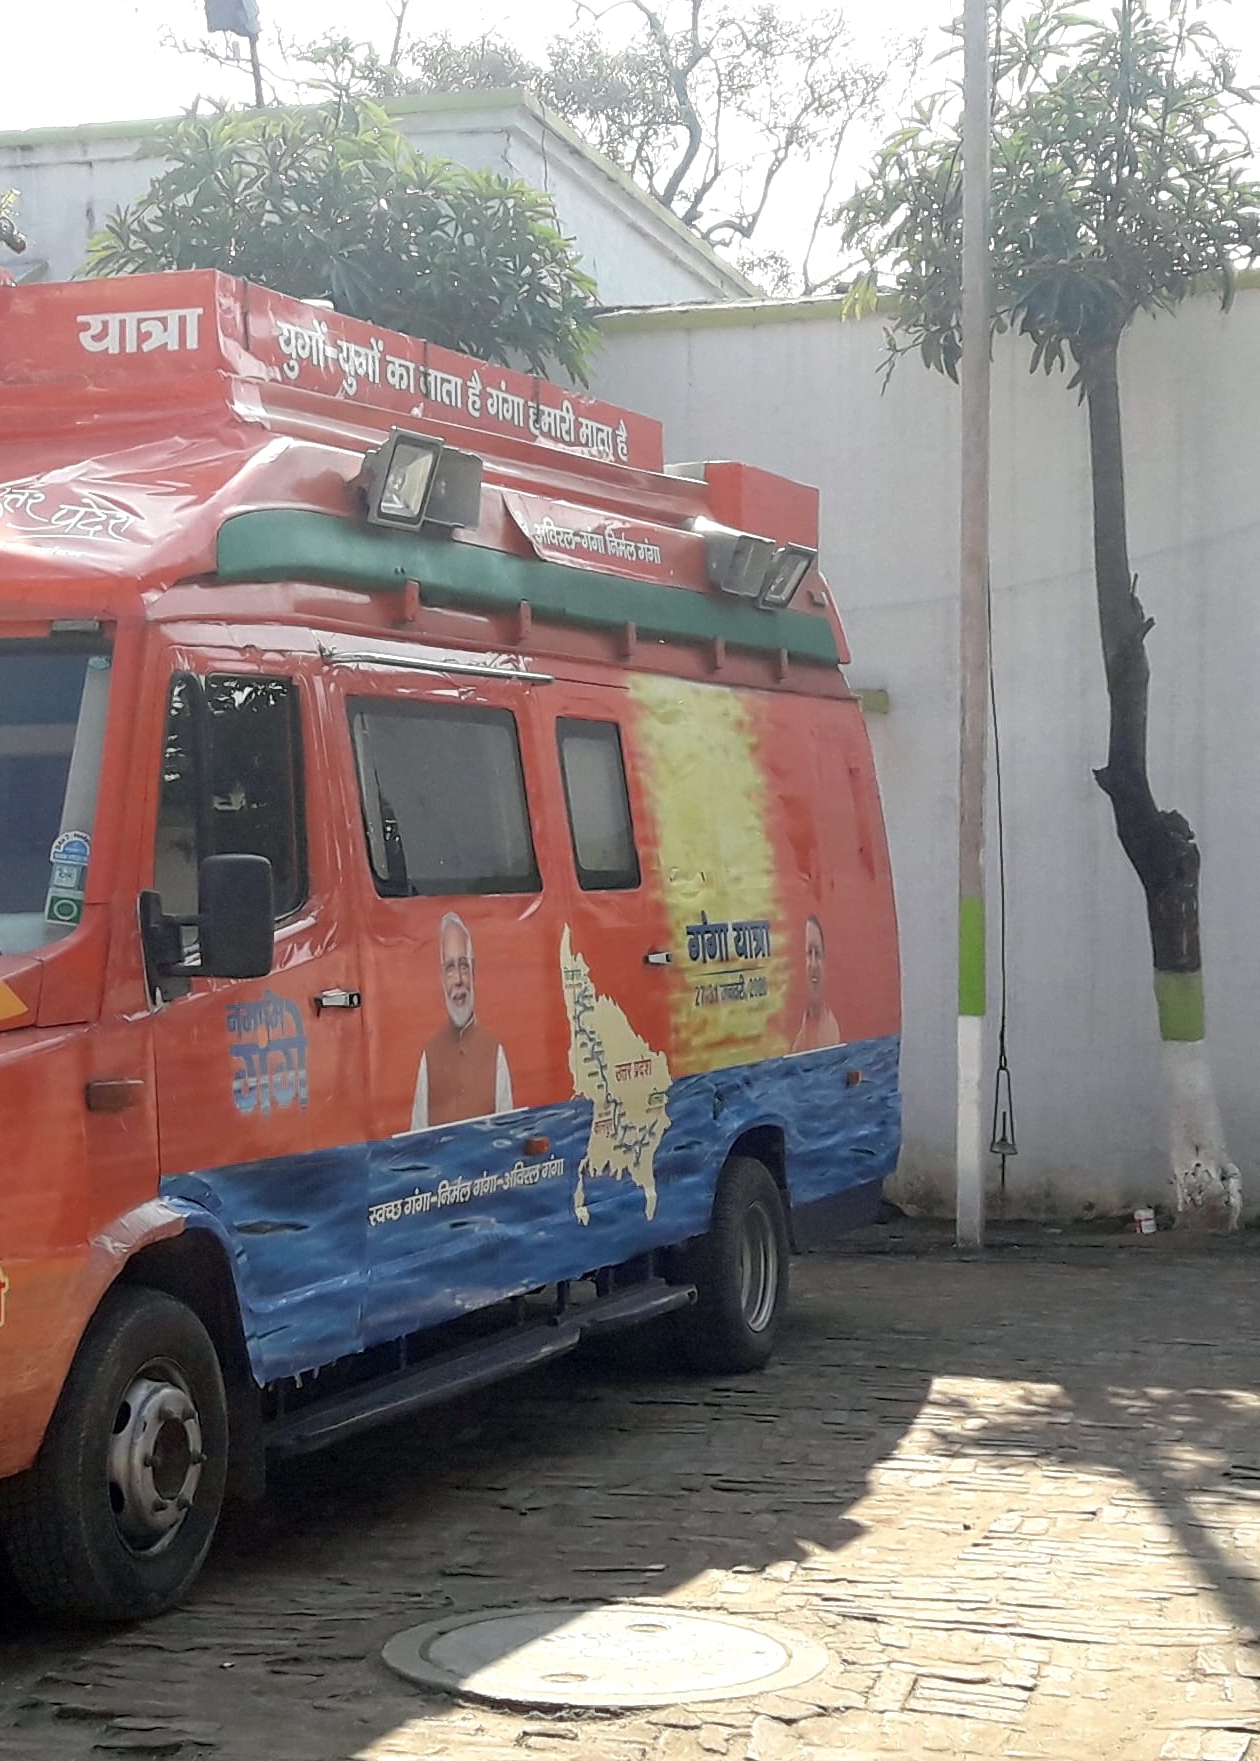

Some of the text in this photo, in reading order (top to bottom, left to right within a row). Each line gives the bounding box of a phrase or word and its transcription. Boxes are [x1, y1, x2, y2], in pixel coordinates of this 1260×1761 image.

[76, 306, 204, 355] यात्रा
[386, 354, 416, 394] का
[467, 369, 482, 418] है
[486, 380, 525, 427] गंगा
[528, 399, 576, 442] हमारी
[578, 416, 615, 459] माता
[615, 418, 629, 462] है
[636, 537, 662, 565] गंगा
[686, 910, 771, 964] गंगा यात्रा
[368, 1198, 402, 1227] स्वच्छ
[540, 1153, 565, 1179] गंगा
